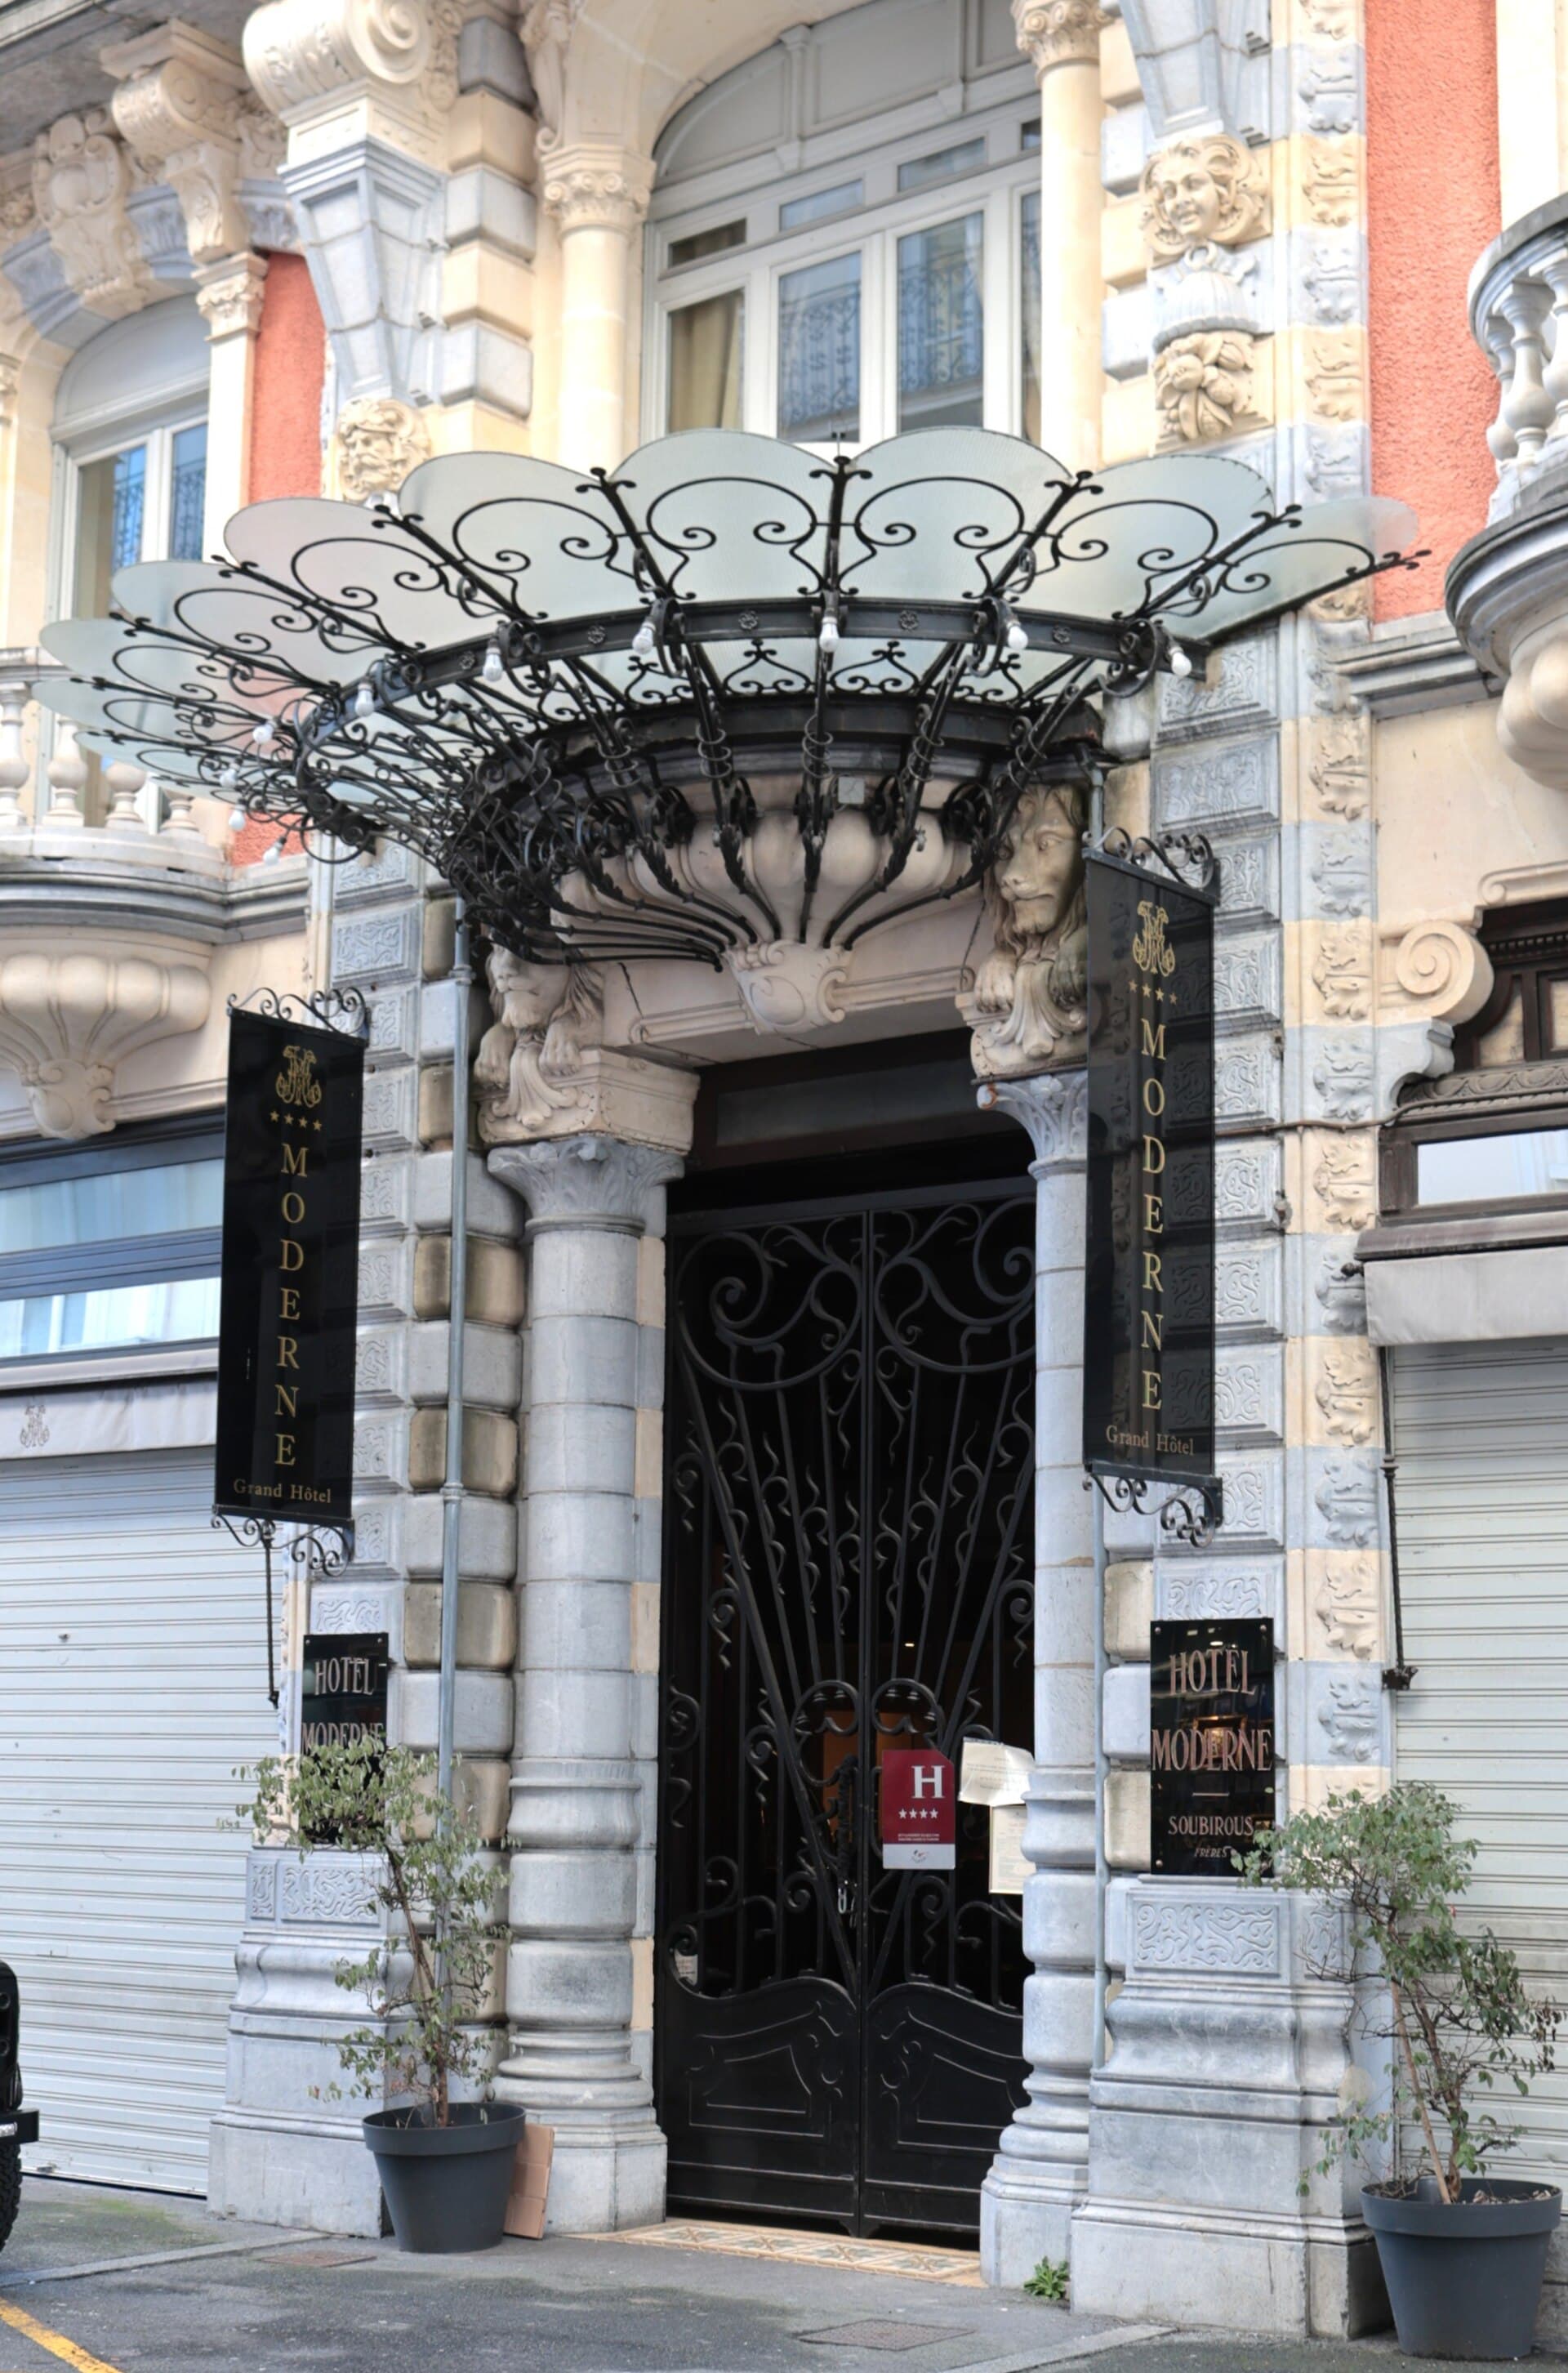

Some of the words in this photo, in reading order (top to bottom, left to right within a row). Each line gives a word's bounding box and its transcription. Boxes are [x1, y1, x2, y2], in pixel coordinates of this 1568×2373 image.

[1141, 1017, 1167, 1411] MODERNE
[274, 1143, 308, 1467] MODERNE
[1106, 1425, 1149, 1448] Grand
[1156, 1433, 1193, 1456] Hôtel
[233, 1478, 283, 1497] Grand
[290, 1483, 332, 1503] Hôtel
[314, 1656, 374, 1696] HOTEL
[1169, 1648, 1256, 1697] HOTEL
[1152, 1728, 1272, 1772] MODERNE
[911, 1764, 946, 1800] H
[1168, 1815, 1254, 1836] SOUBIROUS
